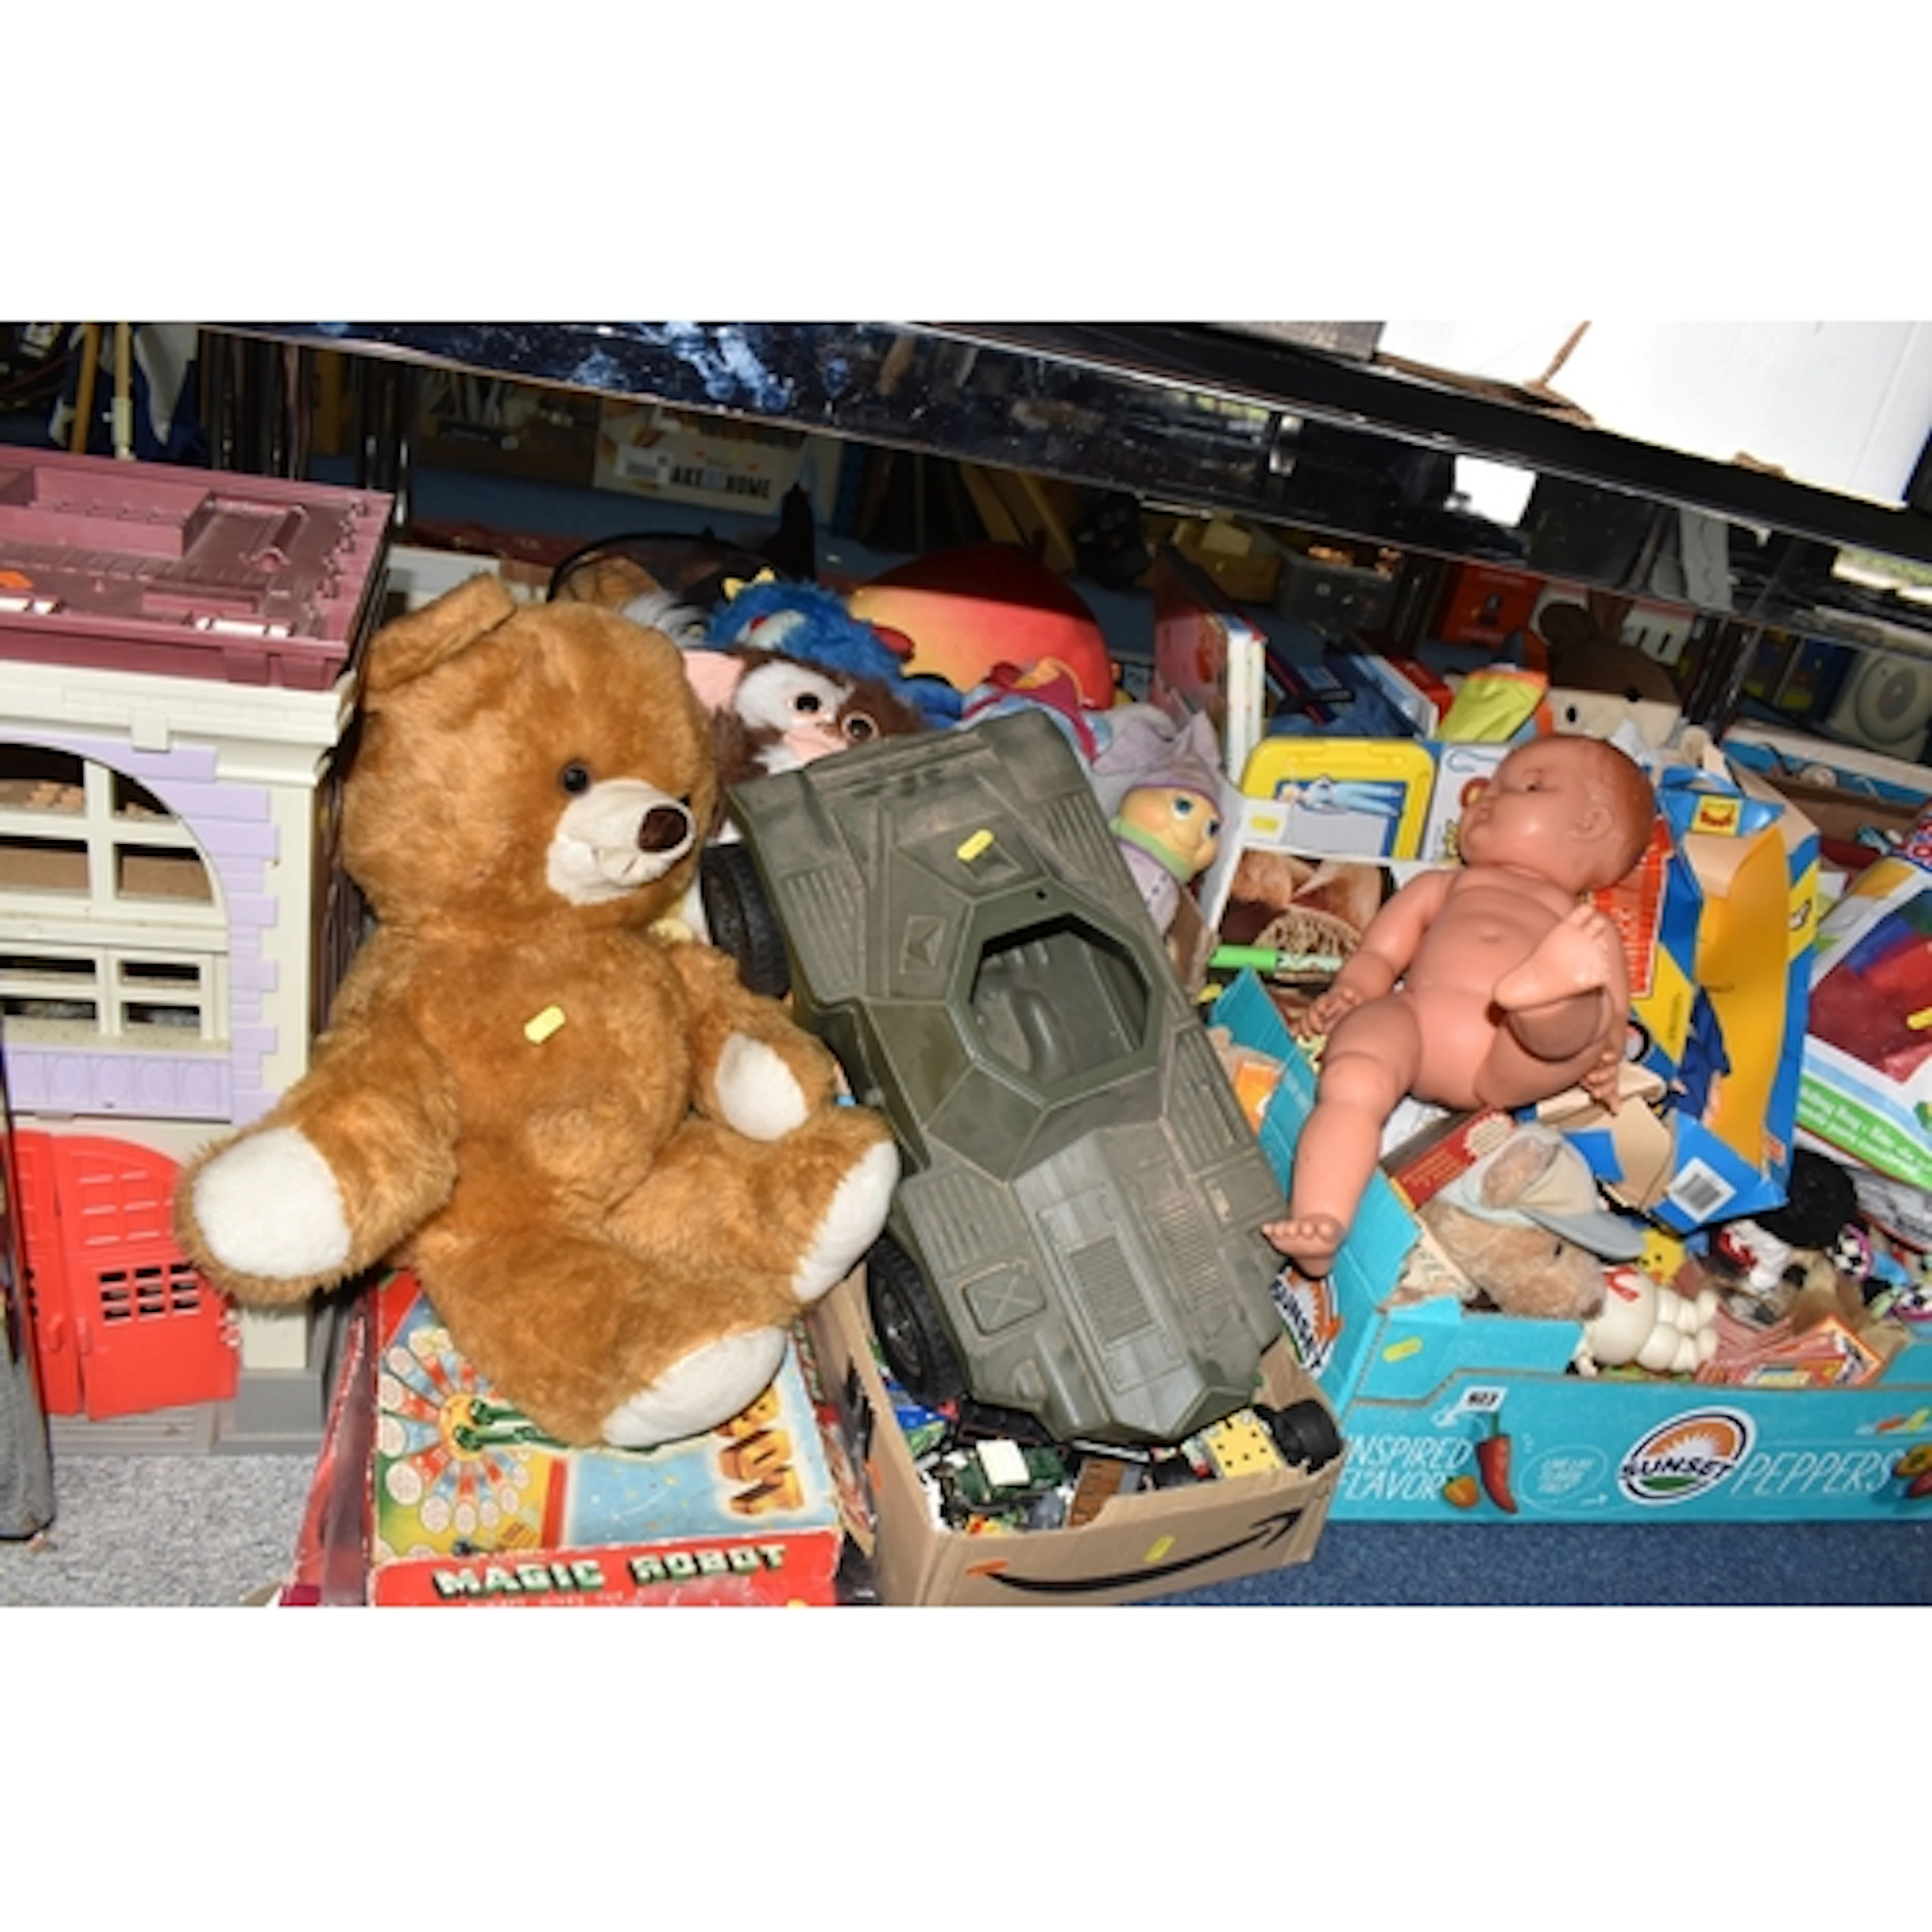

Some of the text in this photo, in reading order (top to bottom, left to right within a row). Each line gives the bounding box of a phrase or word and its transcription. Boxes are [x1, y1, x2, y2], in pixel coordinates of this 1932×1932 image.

[670, 465, 703, 487] AKE
[726, 472, 773, 499] HOME
[1345, 1434, 1473, 1470] NSPIRED
[1621, 1454, 1733, 1480] SUNSET
[1731, 1447, 1904, 1496] PEPPERS
[434, 1560, 605, 1599] MAGIC
[628, 1545, 786, 1584] ROBOT
